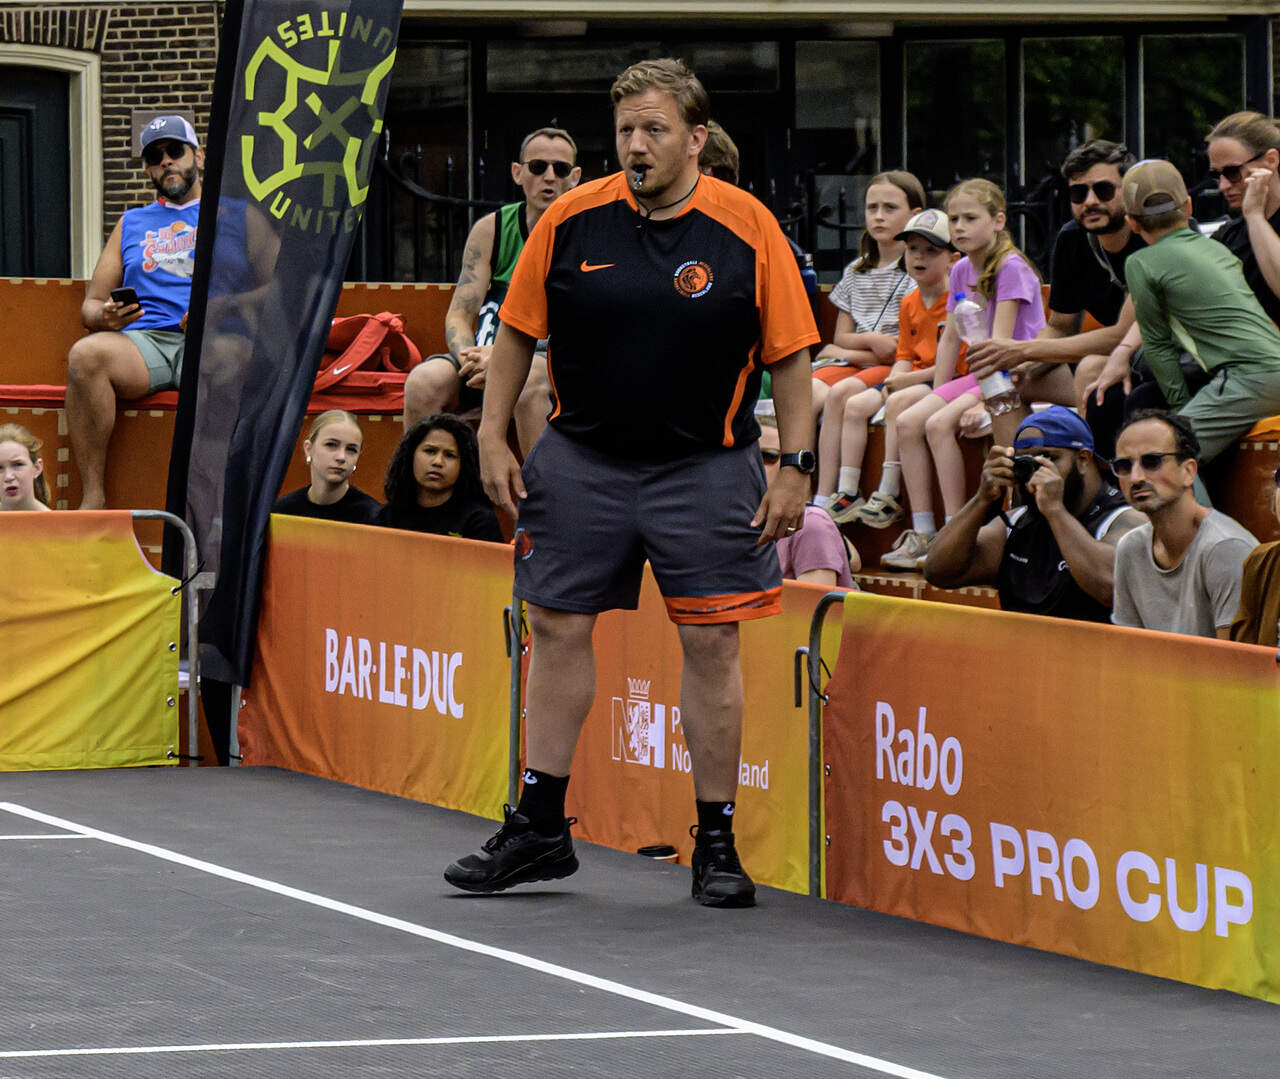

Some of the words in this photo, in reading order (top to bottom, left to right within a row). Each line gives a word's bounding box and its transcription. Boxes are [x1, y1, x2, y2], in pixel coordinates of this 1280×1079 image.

[269, 190, 363, 235] UNITE
[875, 701, 964, 796] Rabo
[881, 800, 976, 882] 3X3
[989, 822, 1100, 911] PRO
[1115, 850, 1254, 939] CUP
